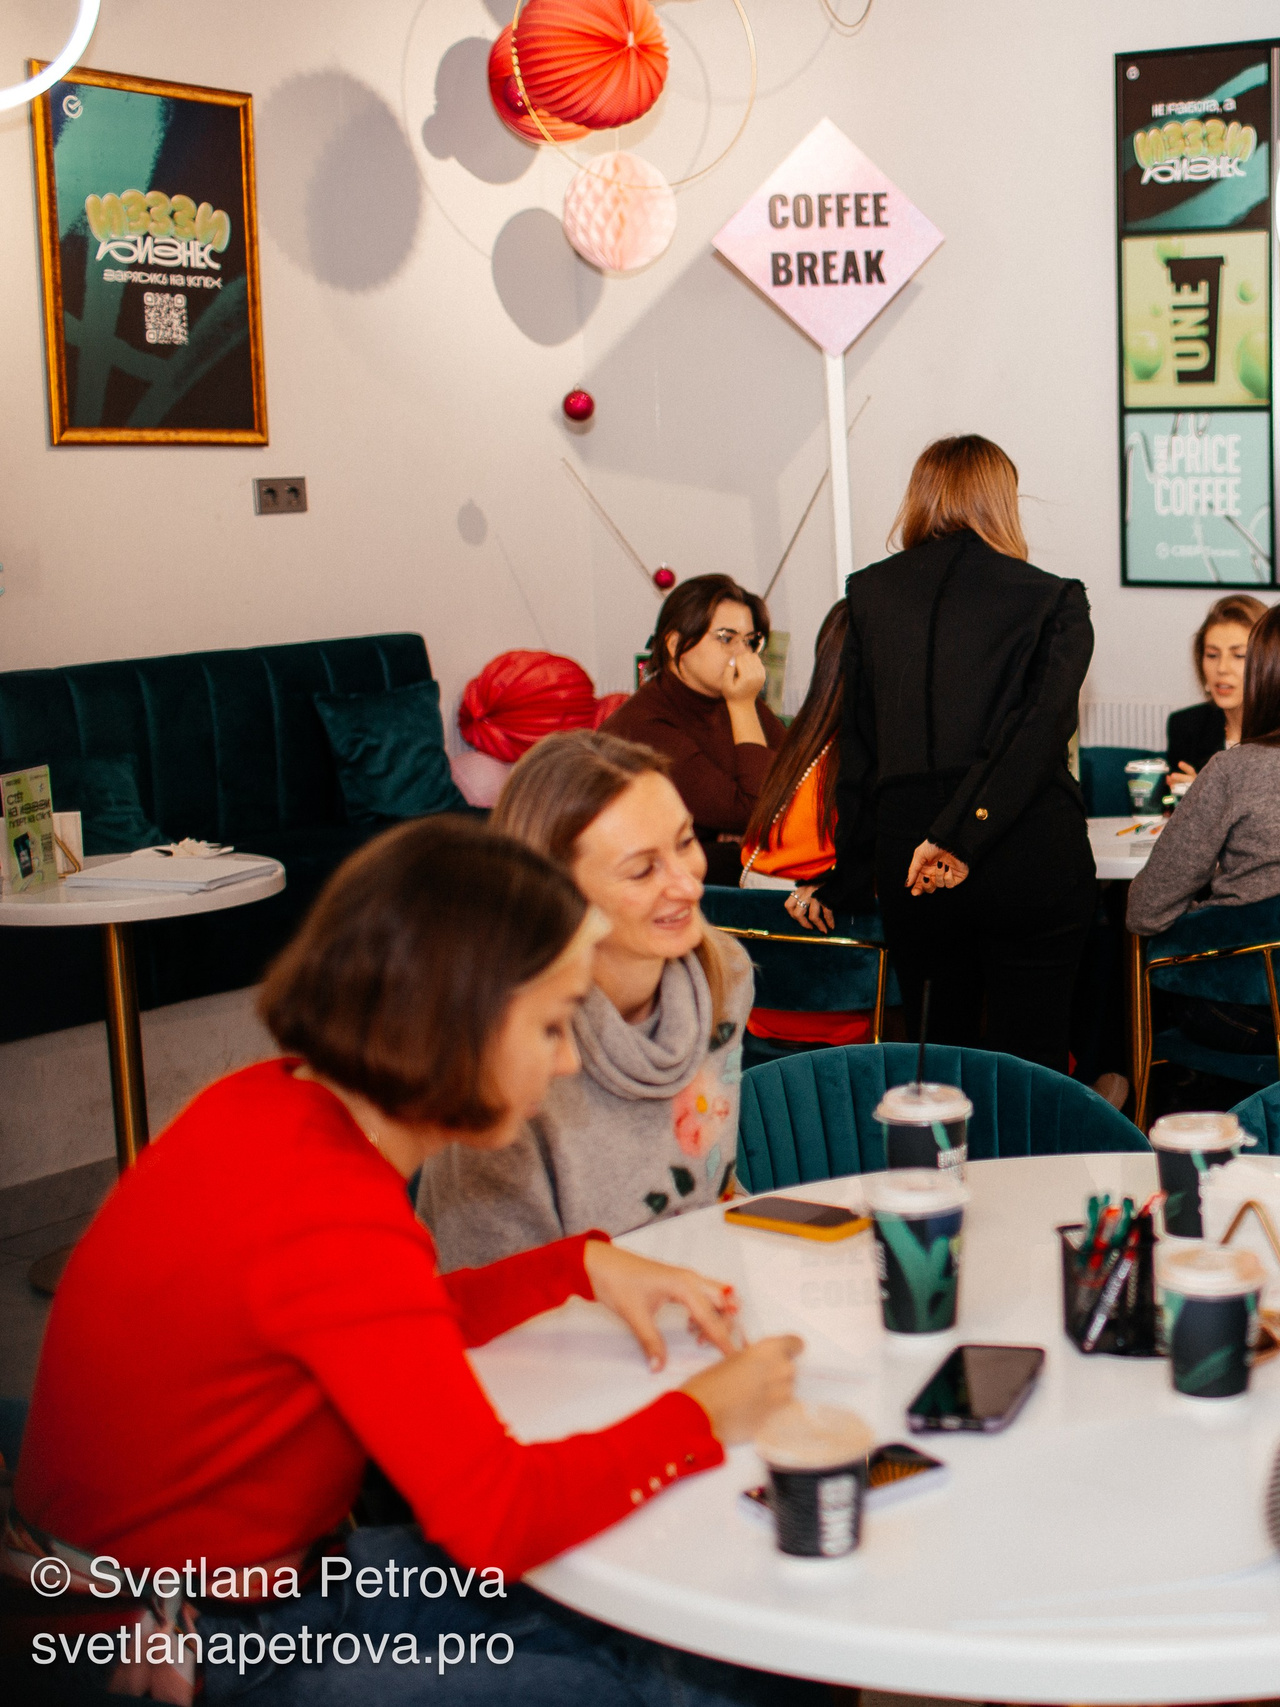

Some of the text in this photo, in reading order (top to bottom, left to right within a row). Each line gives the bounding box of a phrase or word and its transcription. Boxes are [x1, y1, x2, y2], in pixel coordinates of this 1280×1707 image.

[768, 192, 889, 229] COFFEE
[771, 249, 886, 286] BREAK
[1171, 434, 1242, 473] PRICE
[1154, 476, 1242, 517] COFFEE
